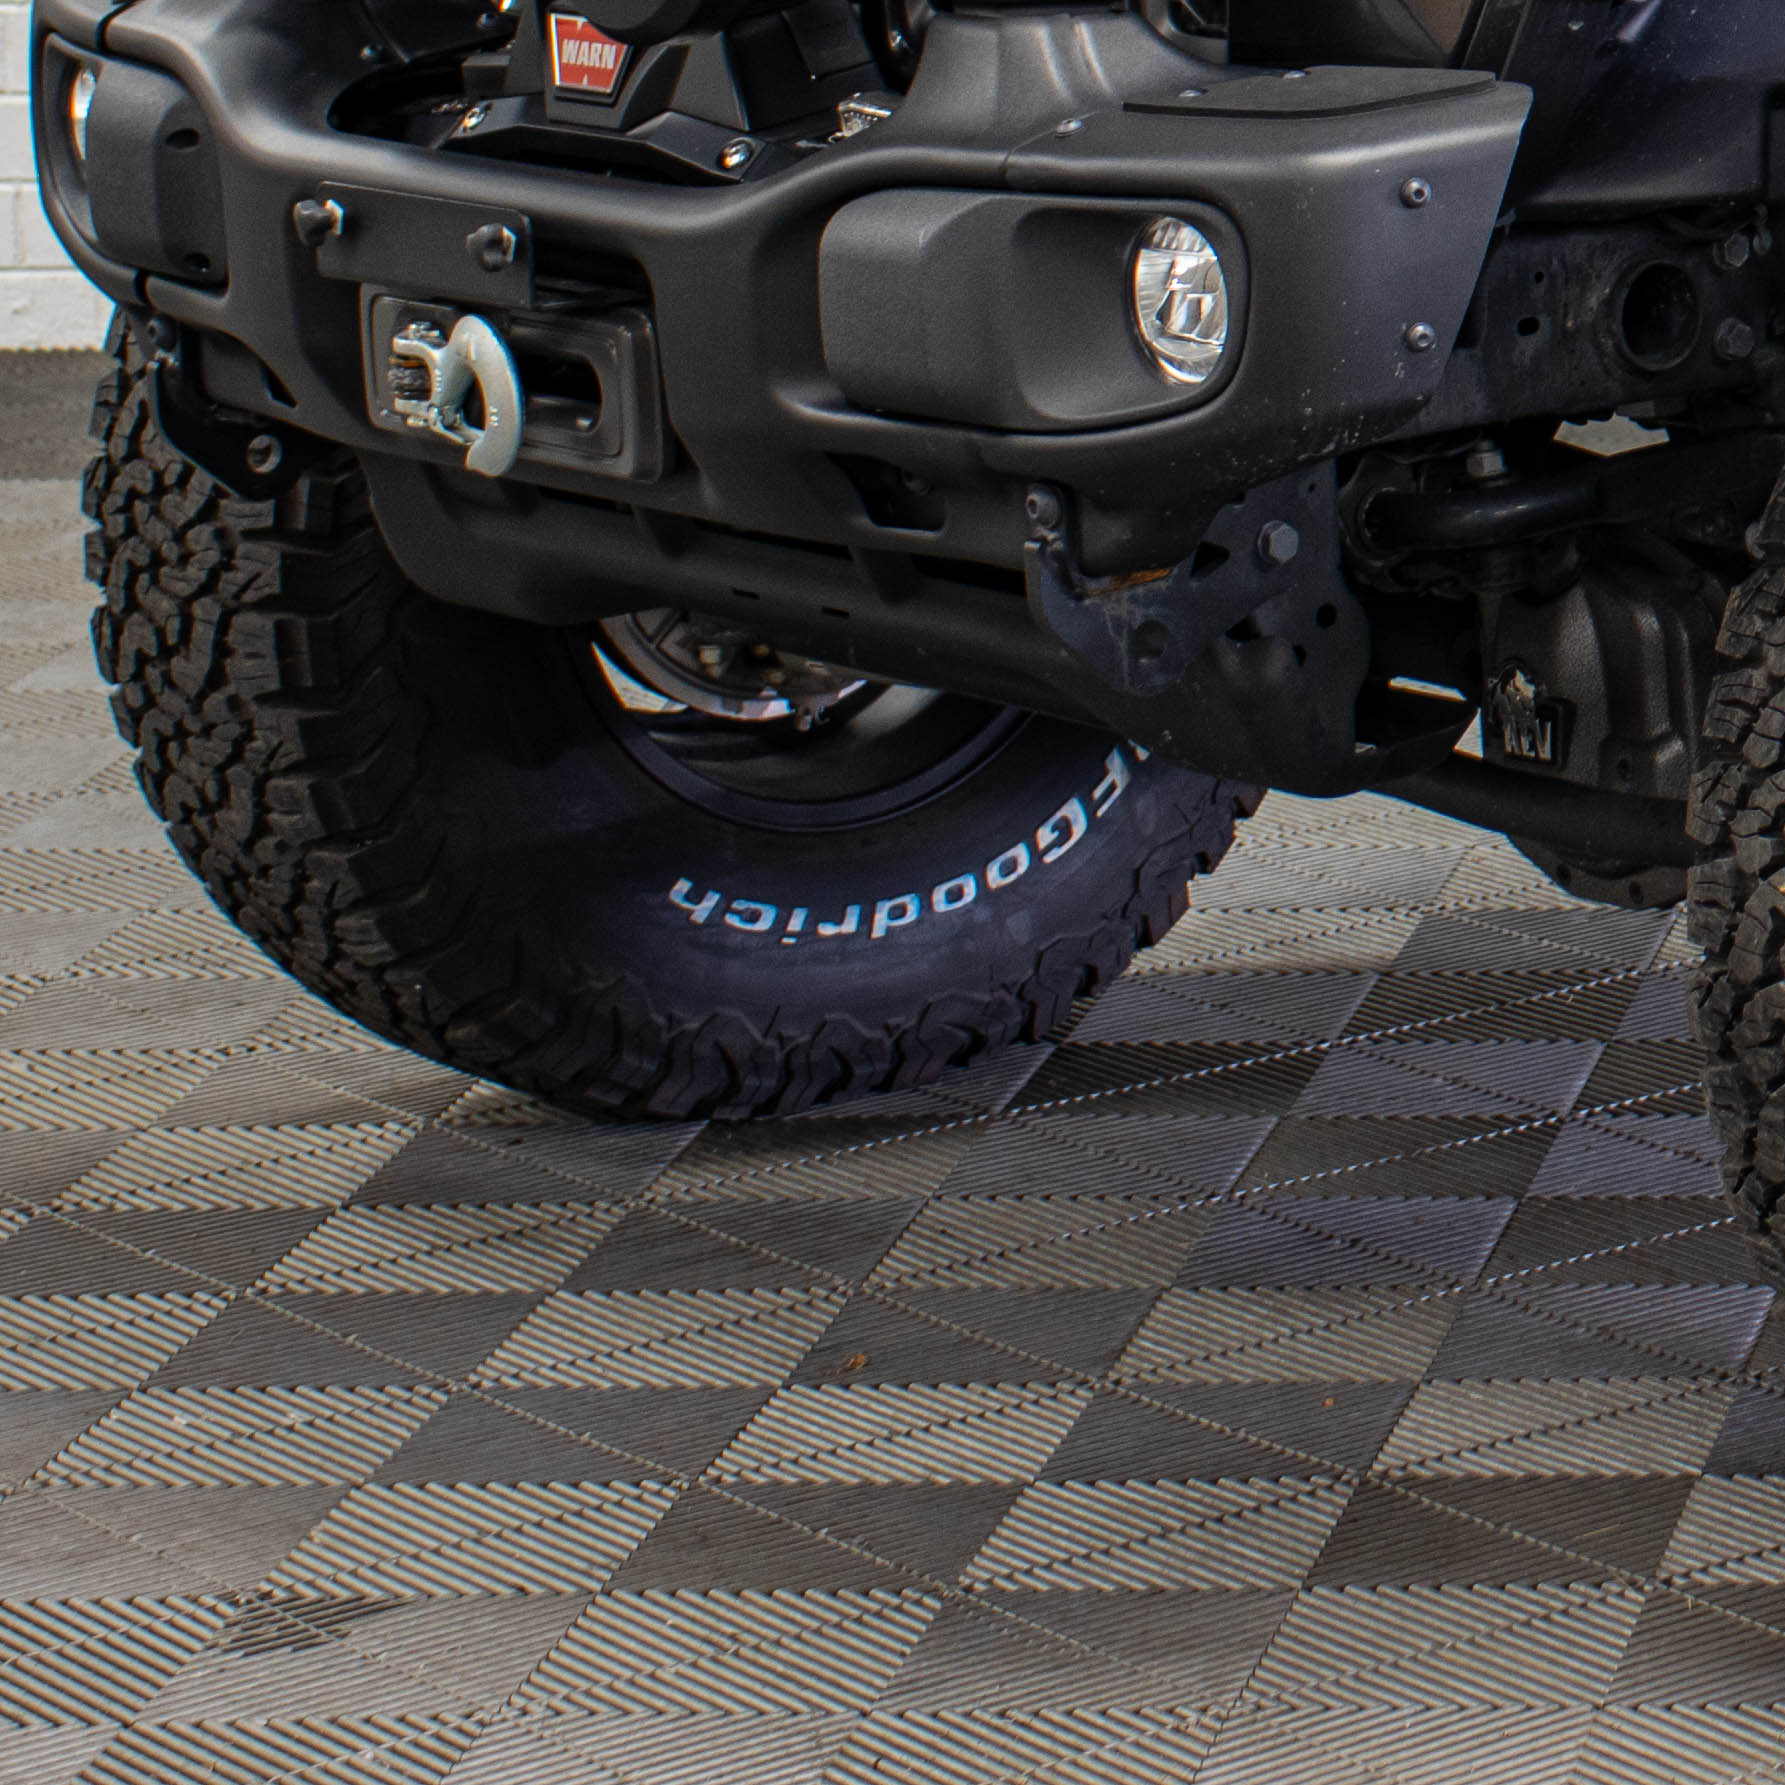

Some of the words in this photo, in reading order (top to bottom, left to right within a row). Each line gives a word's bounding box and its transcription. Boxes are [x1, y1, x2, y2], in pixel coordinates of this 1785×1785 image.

[561, 38, 617, 70] WARN
[1503, 716, 1553, 761] AEV
[667, 742, 1151, 945] FGoodrich
